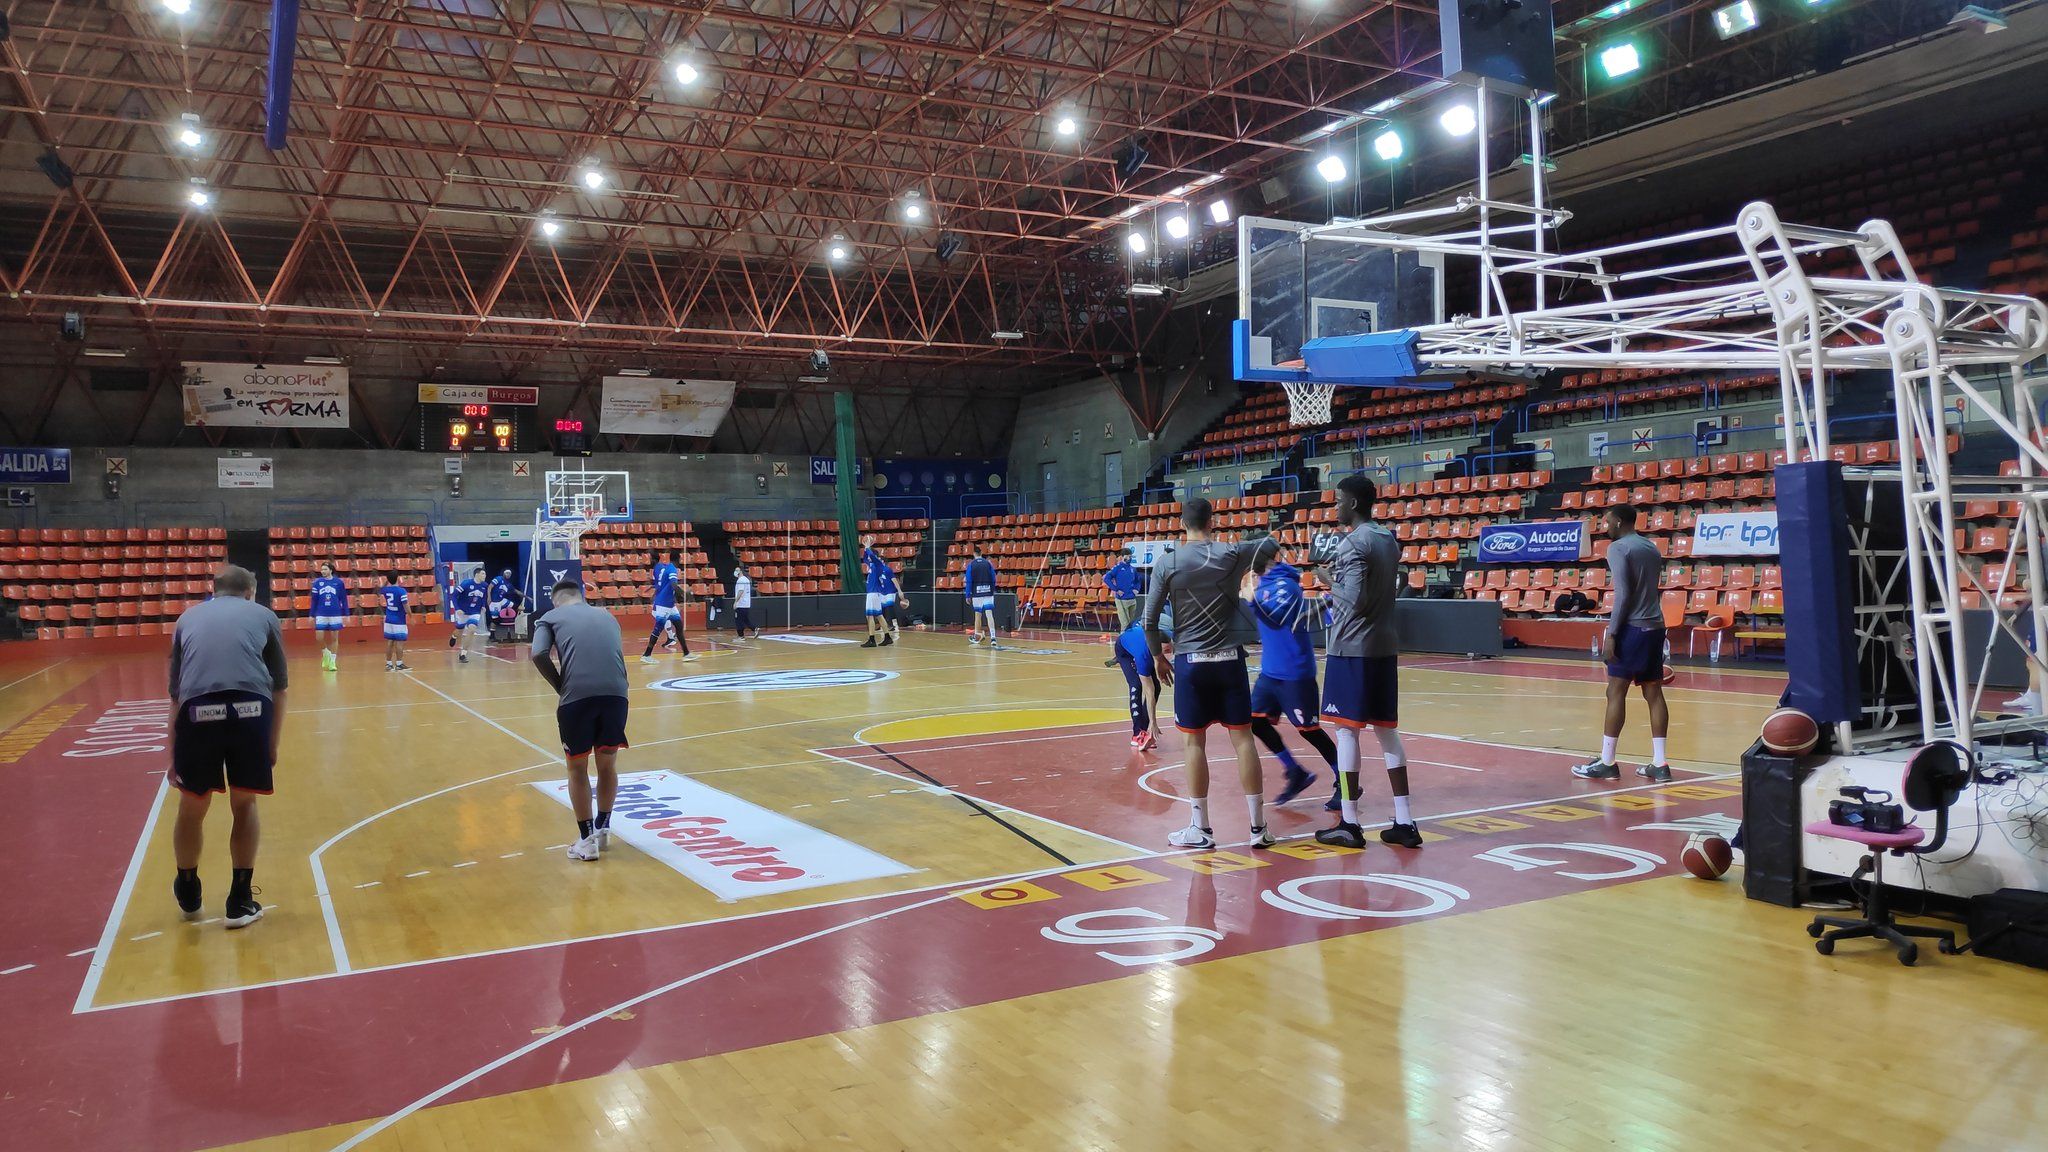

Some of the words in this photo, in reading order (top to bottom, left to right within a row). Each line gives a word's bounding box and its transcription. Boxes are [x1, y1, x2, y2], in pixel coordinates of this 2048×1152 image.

[243, 372, 328, 387] abonoPlus
[442, 388, 467, 398] Caja
[471, 389, 484, 398] de
[492, 389, 531, 402] Burgos
[237, 399, 254, 408] en
[453, 425, 467, 435] 00
[496, 426, 509, 436] 00
[452, 437, 459, 446] 0
[500, 438, 507, 447] 0
[0, 453, 49, 473] ALIDA
[1528, 528, 1578, 544] Autocid
[1699, 521, 1735, 541] tpr
[1489, 535, 1517, 550] Ford
